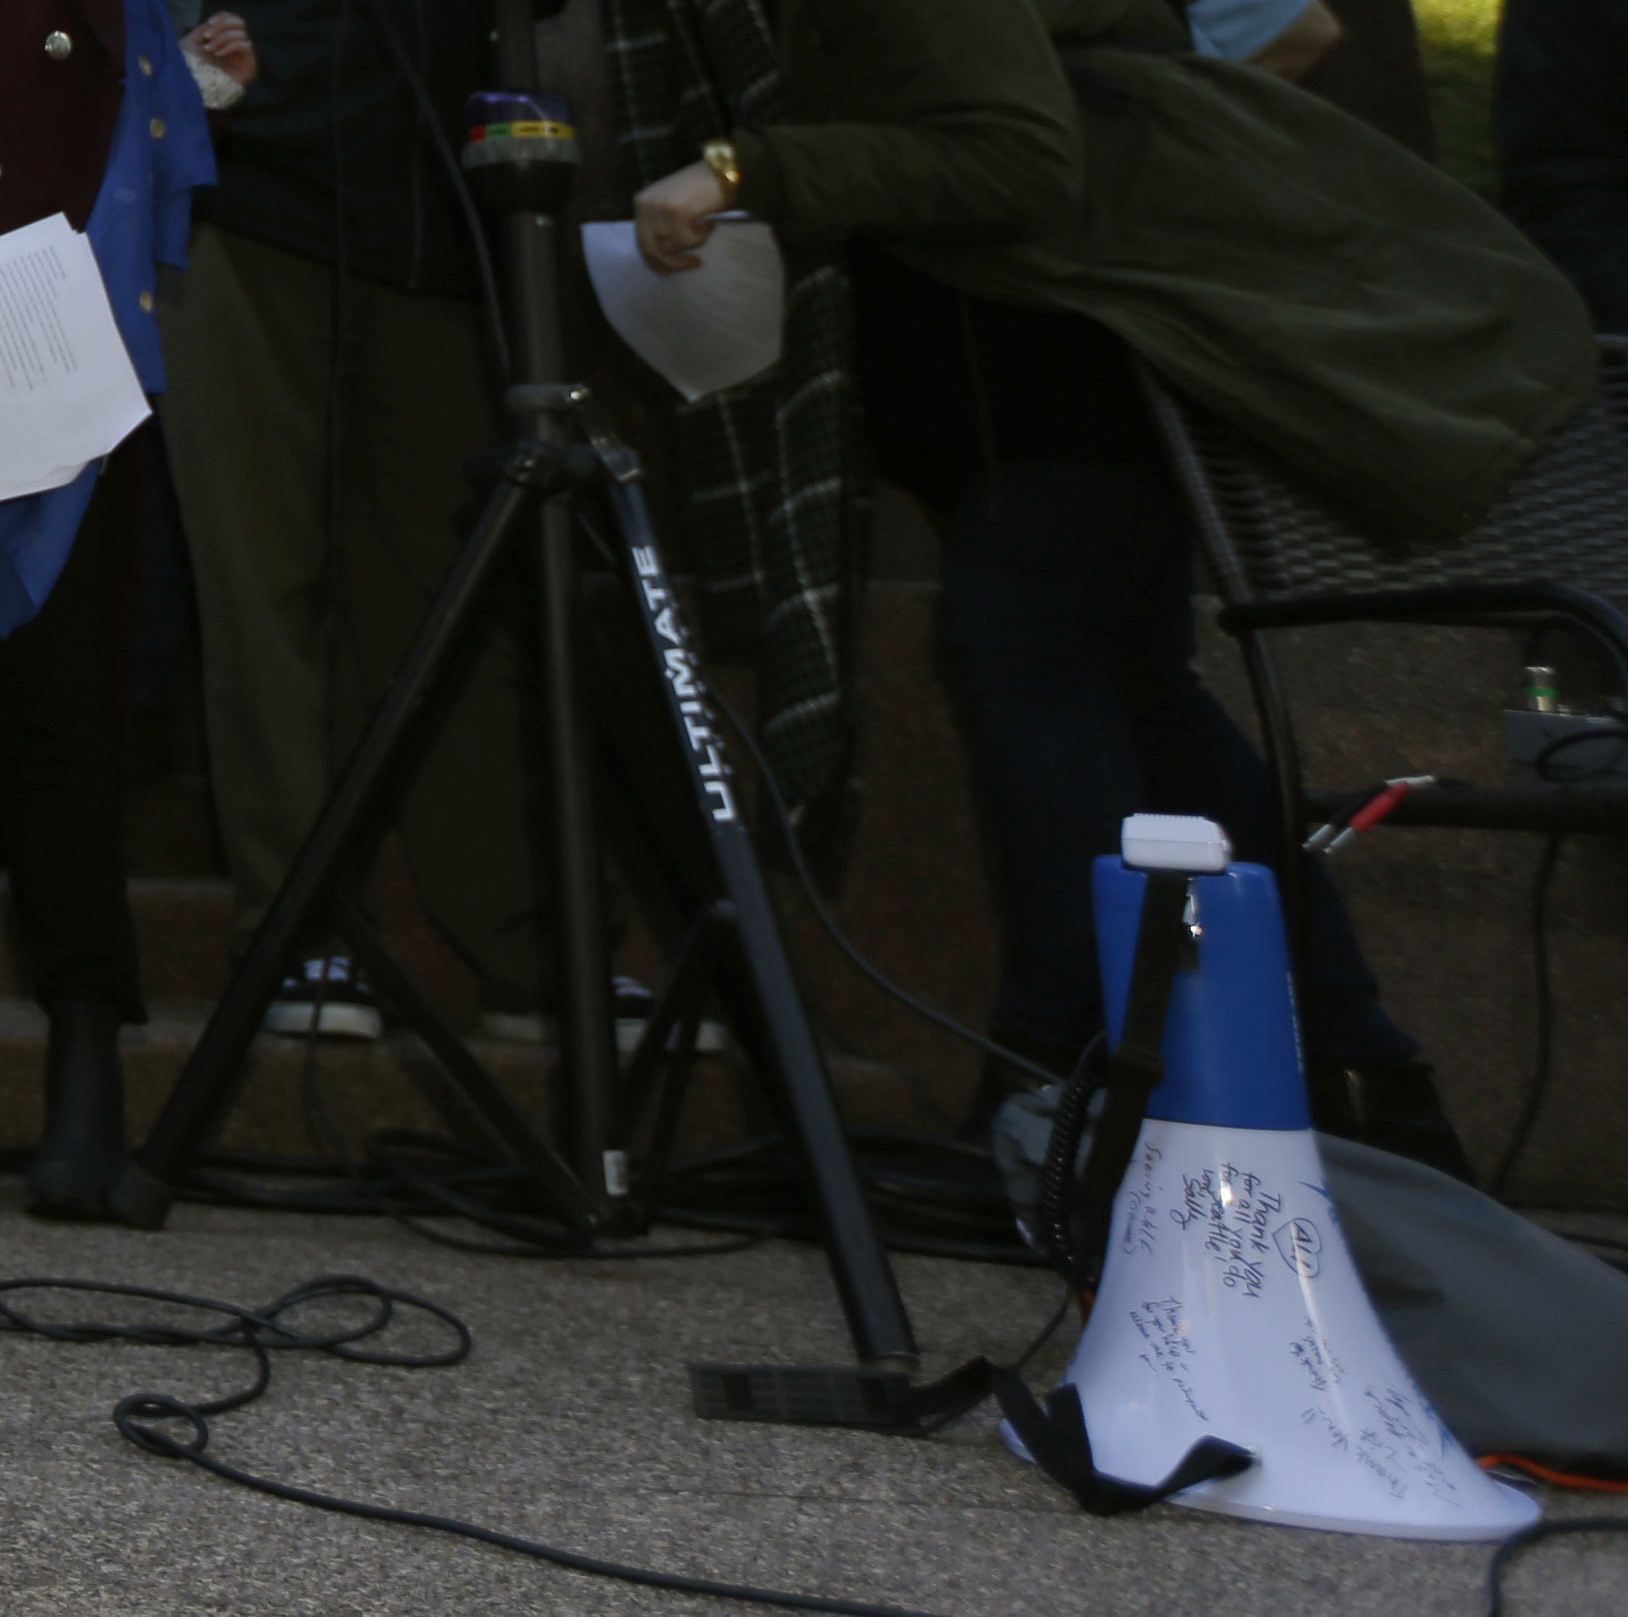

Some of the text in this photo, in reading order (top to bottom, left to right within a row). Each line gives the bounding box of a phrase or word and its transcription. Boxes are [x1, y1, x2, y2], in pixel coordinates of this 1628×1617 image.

[632, 545, 734, 822] ULTIMATE
[1240, 1191, 1282, 1299] Thank you
